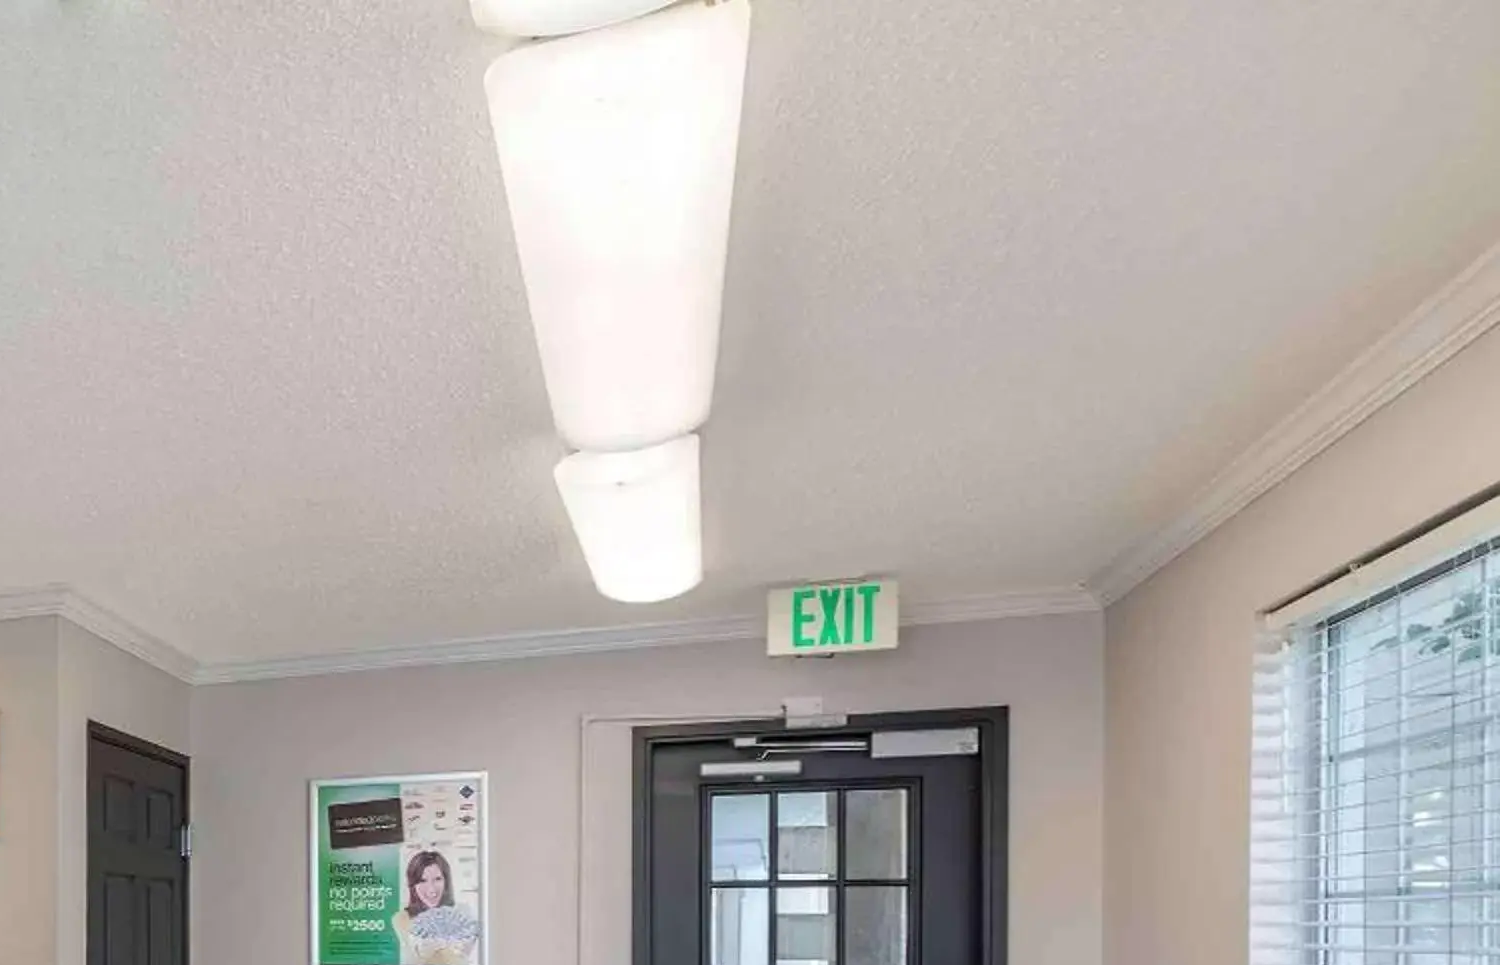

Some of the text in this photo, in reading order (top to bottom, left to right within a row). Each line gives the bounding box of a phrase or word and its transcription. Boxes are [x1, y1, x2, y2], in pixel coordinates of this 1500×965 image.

[792, 585, 881, 648] EXIT
[329, 860, 373, 874] instant
[329, 886, 393, 901] no points
[329, 898, 385, 912] required
